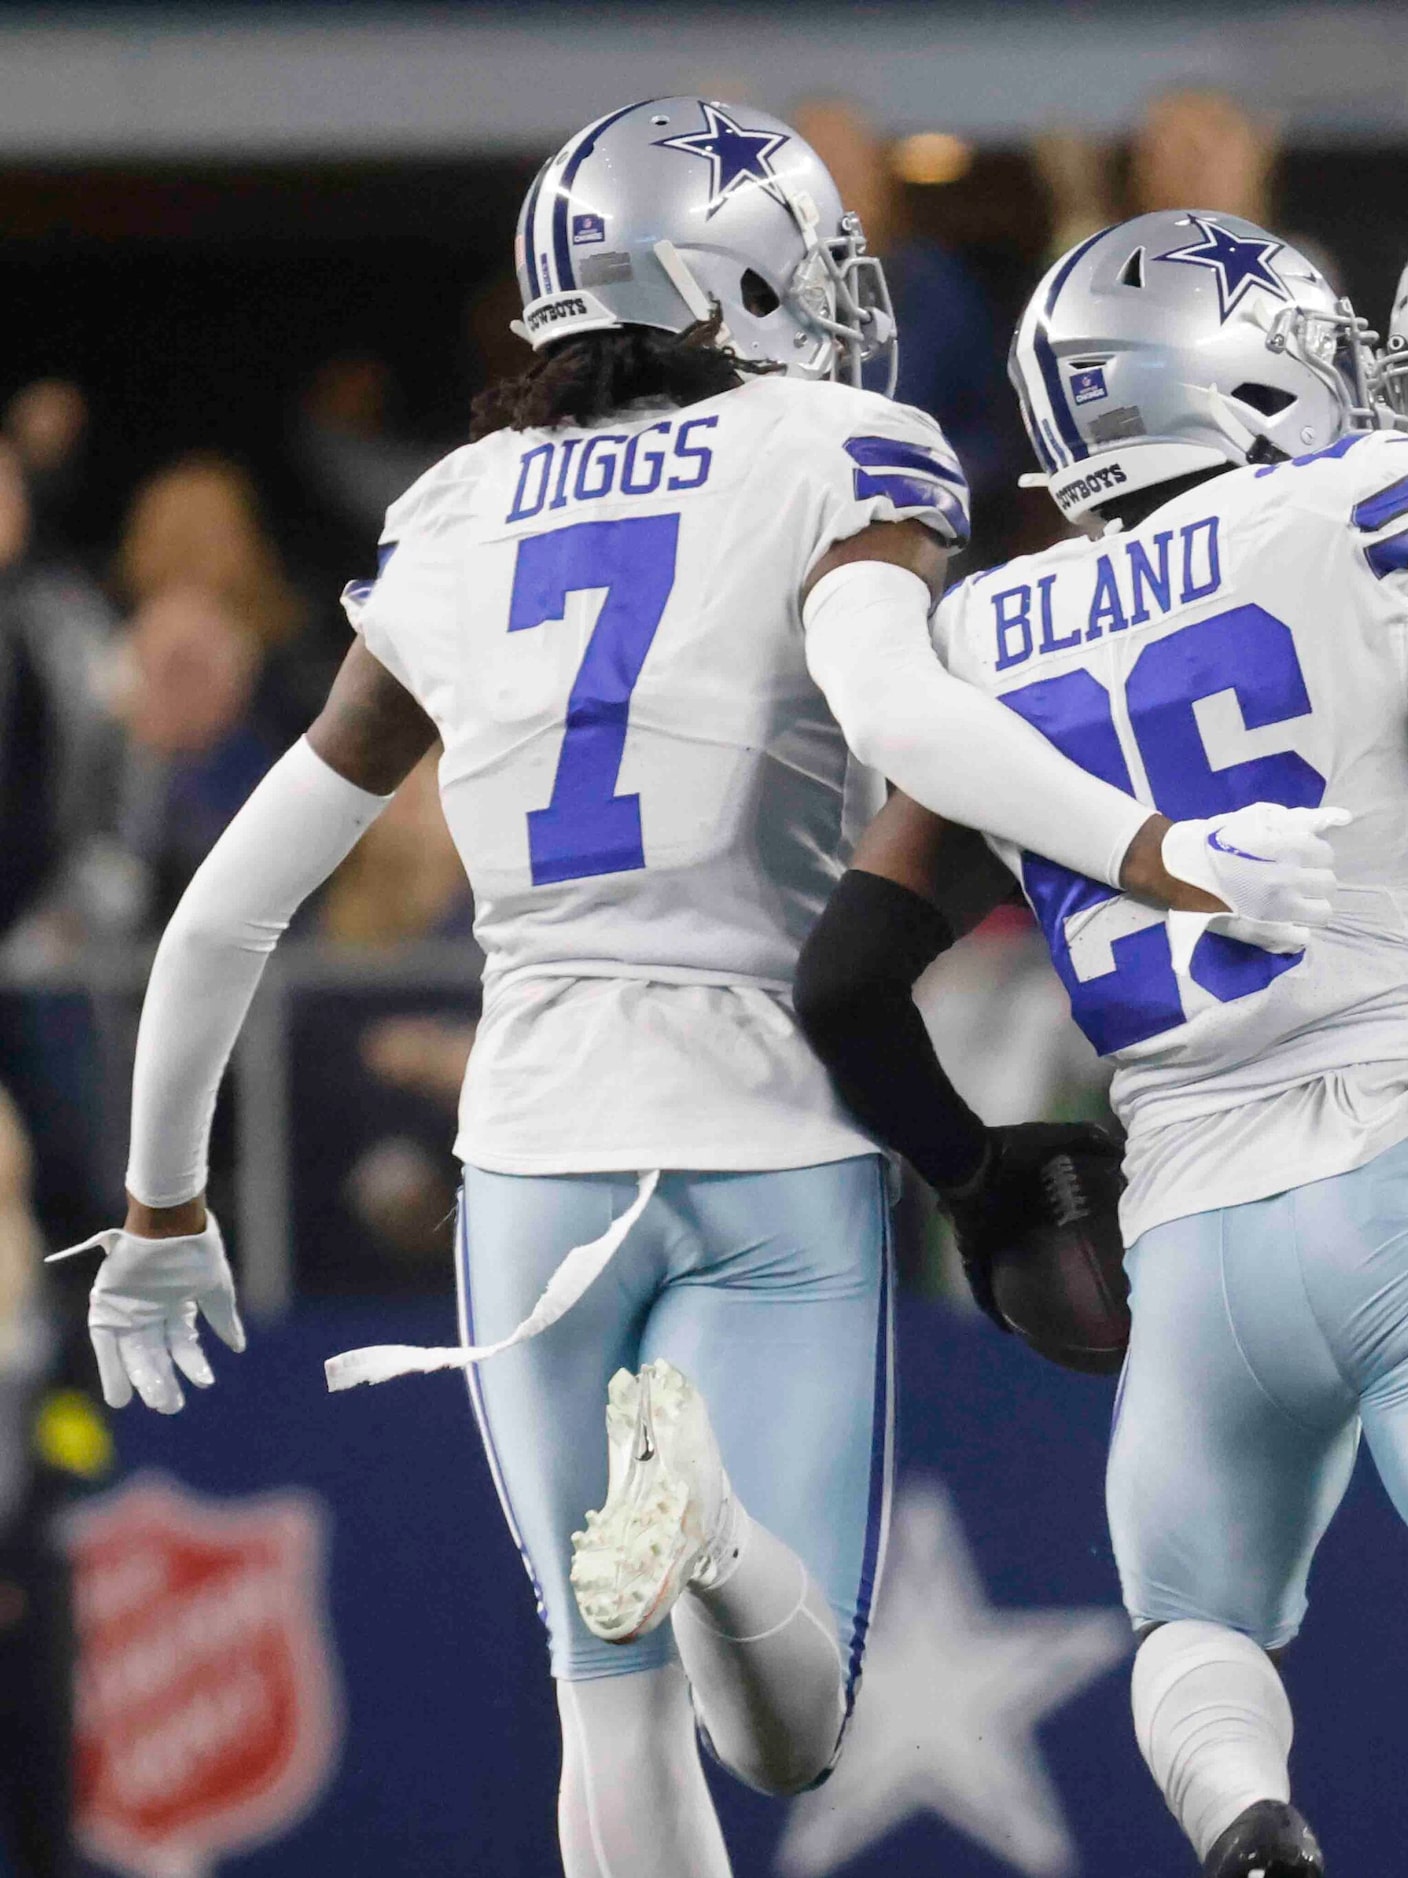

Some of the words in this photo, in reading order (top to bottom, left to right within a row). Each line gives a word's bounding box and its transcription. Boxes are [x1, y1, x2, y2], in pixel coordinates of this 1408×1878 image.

[506, 415, 719, 523] DIGGS
[991, 516, 1223, 671] BLAND
[507, 513, 681, 887] 7
